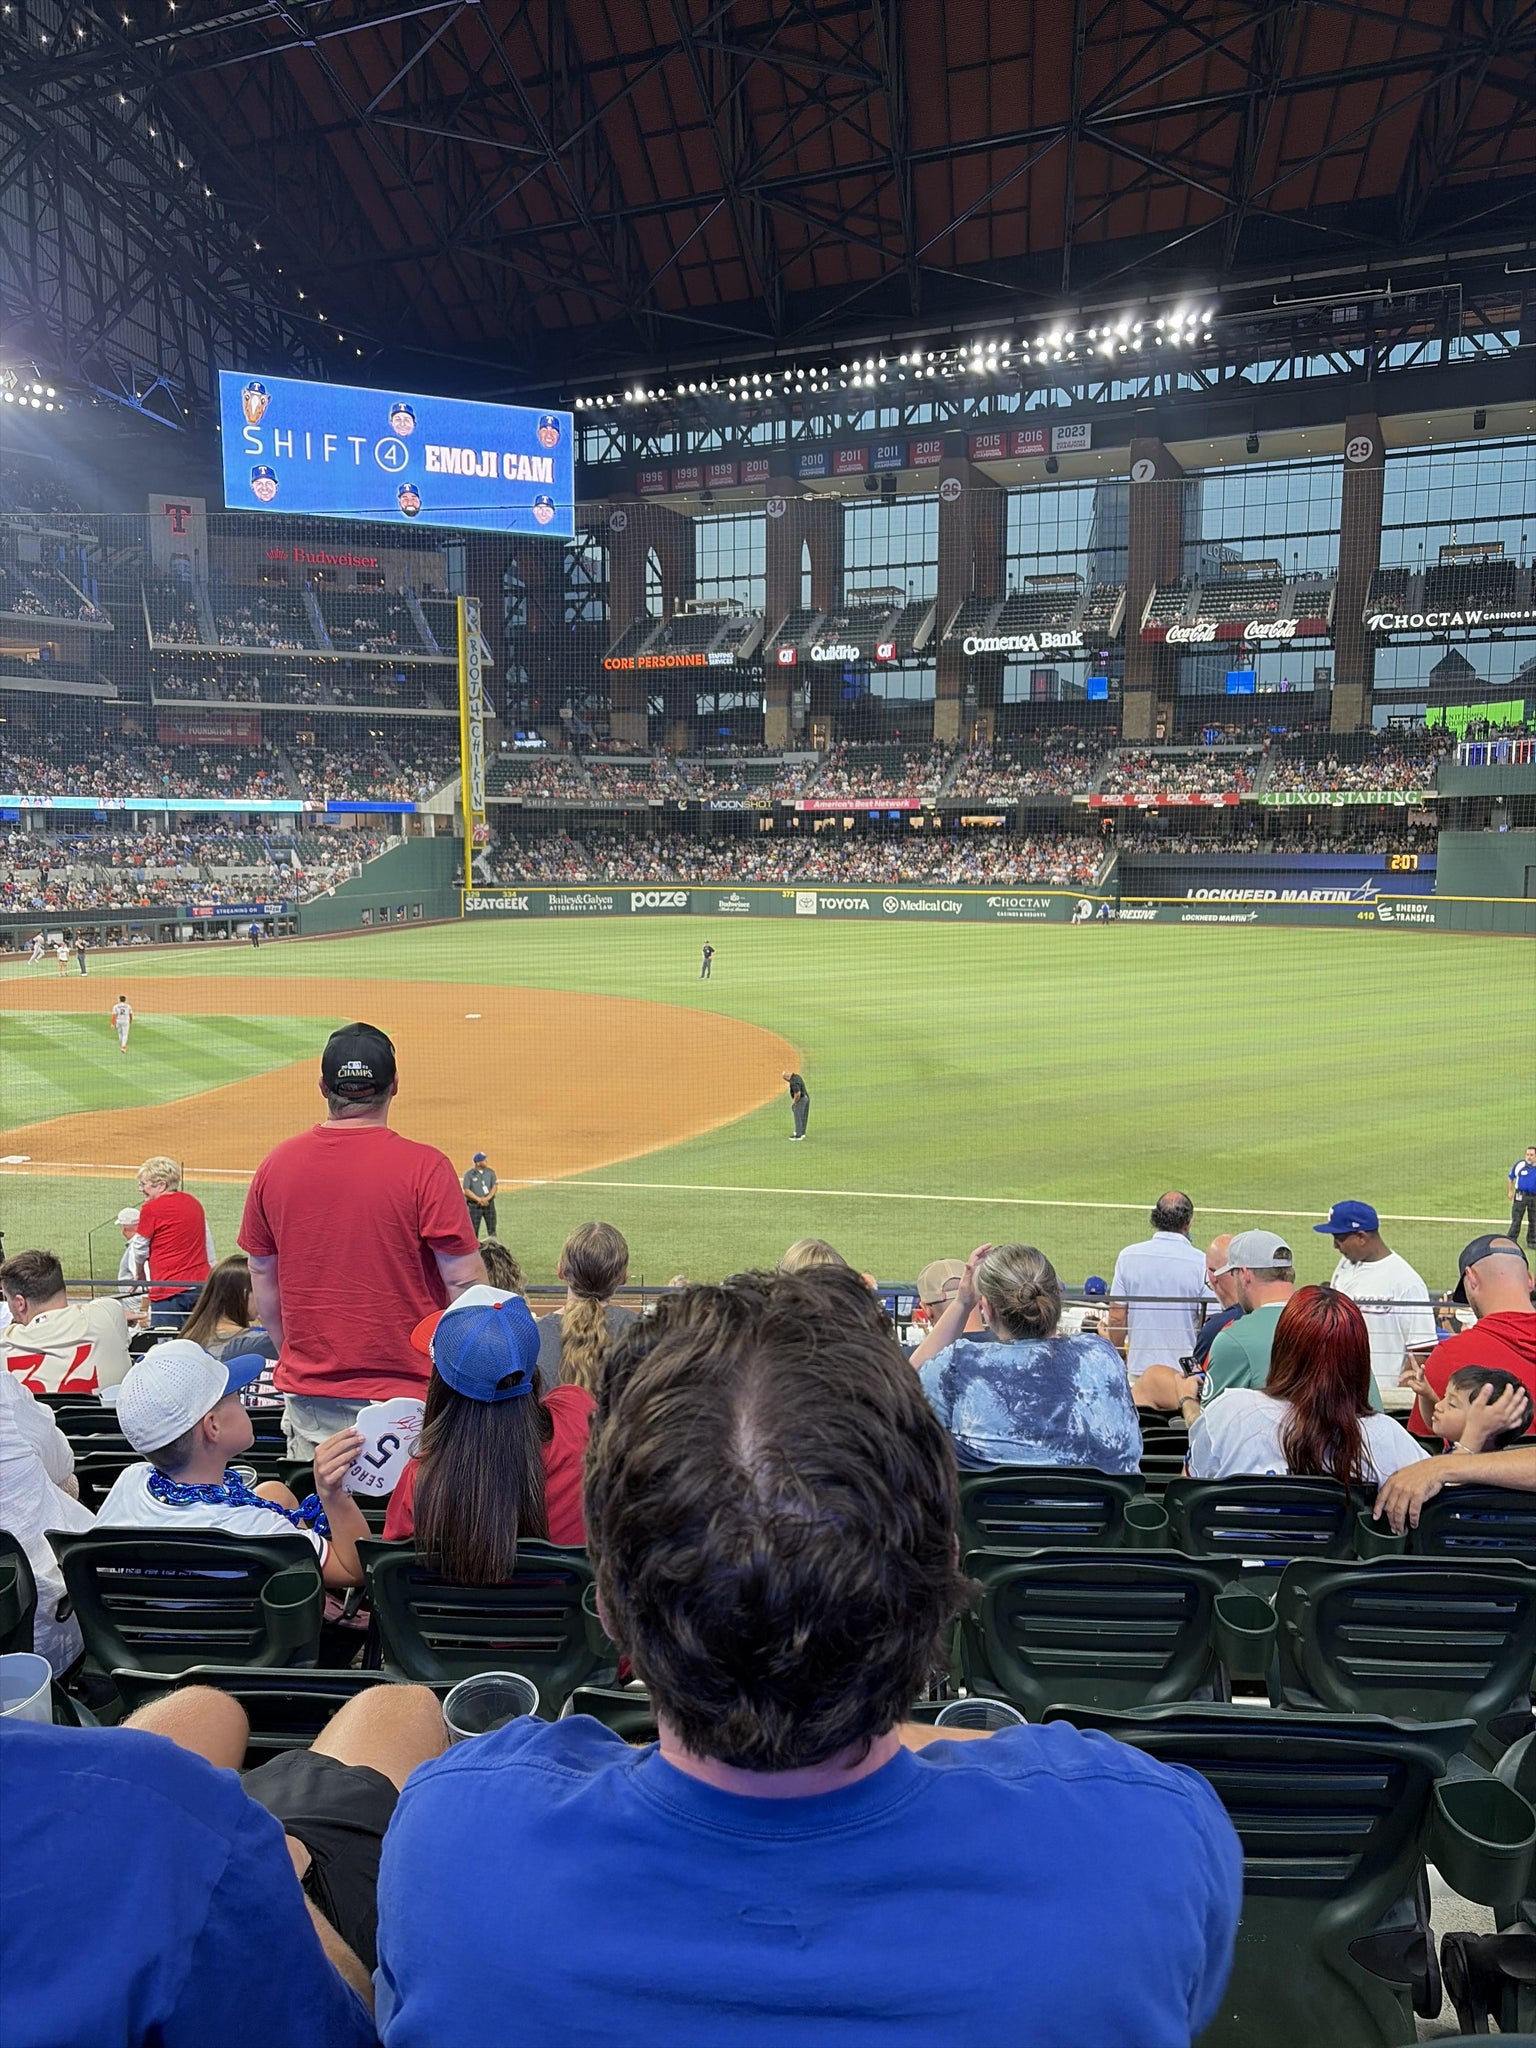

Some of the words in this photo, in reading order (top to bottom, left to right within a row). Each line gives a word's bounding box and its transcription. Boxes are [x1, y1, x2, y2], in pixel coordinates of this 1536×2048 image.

[1018, 430, 1042, 443] 2016
[1057, 425, 1086, 439] 2023
[242, 426, 366, 465] SHIFT
[917, 441, 940, 453] 2012
[976, 434, 1000, 447] 2015
[878, 445, 898, 458] 2011
[1349, 441, 1369, 457] 29
[801, 454, 823, 466] 2010
[840, 450, 861, 462] 2011
[425, 445, 500, 478] EMOJI
[502, 454, 555, 483] CAM
[711, 463, 732, 475] 1999
[747, 460, 769, 472] 2010
[642, 471, 663, 483] 1996
[677, 467, 698, 479] 1998
[1138, 464, 1149, 480] 7
[942, 483, 959, 497] 26
[767, 500, 785, 514] 34
[611, 515, 626, 528] 42
[1378, 611, 1483, 630] CHOCTAW
[1483, 612, 1522, 621] CASINOS
[1040, 630, 1083, 648] Bank
[779, 650, 793, 663] QT
[810, 645, 860, 662] QuikTrip
[878, 644, 894, 657] QT
[469, 639, 480, 694] ROOT
[604, 657, 634, 670] CORE
[638, 654, 708, 668] PERSONNEL
[470, 703, 480, 716] 4
[188, 727, 233, 736] FOUNDATION
[710, 800, 772, 808] MOONSHOT
[813, 800, 852, 808] America's
[854, 800, 873, 808] Best
[874, 799, 910, 808] Network
[986, 796, 1019, 804] ARENA
[1275, 793, 1331, 804] LUXOR
[1335, 792, 1418, 804] STAFFING
[1391, 855, 1418, 870] 2:07
[782, 890, 795, 898] 372
[1187, 888, 1277, 900] LOCKHEED
[1281, 890, 1351, 902] MARTIN
[465, 897, 529, 911] SEATGEEK
[631, 891, 688, 912] paze
[819, 898, 870, 910] TOYOTA
[900, 900, 940, 911] Medical
[941, 901, 963, 914] City
[993, 896, 1051, 907] CHOCTAW
[1396, 904, 1428, 913] ENERGY
[1181, 913, 1217, 921] LOCKHEED
[1219, 914, 1248, 922] MARTIN
[1357, 911, 1374, 920] 410
[1396, 913, 1435, 923] TRANSFER
[338, 1069, 373, 1078] CHAMPS
[363, 1432, 401, 1469] 5
[349, 1459, 385, 1489] SEAGE
